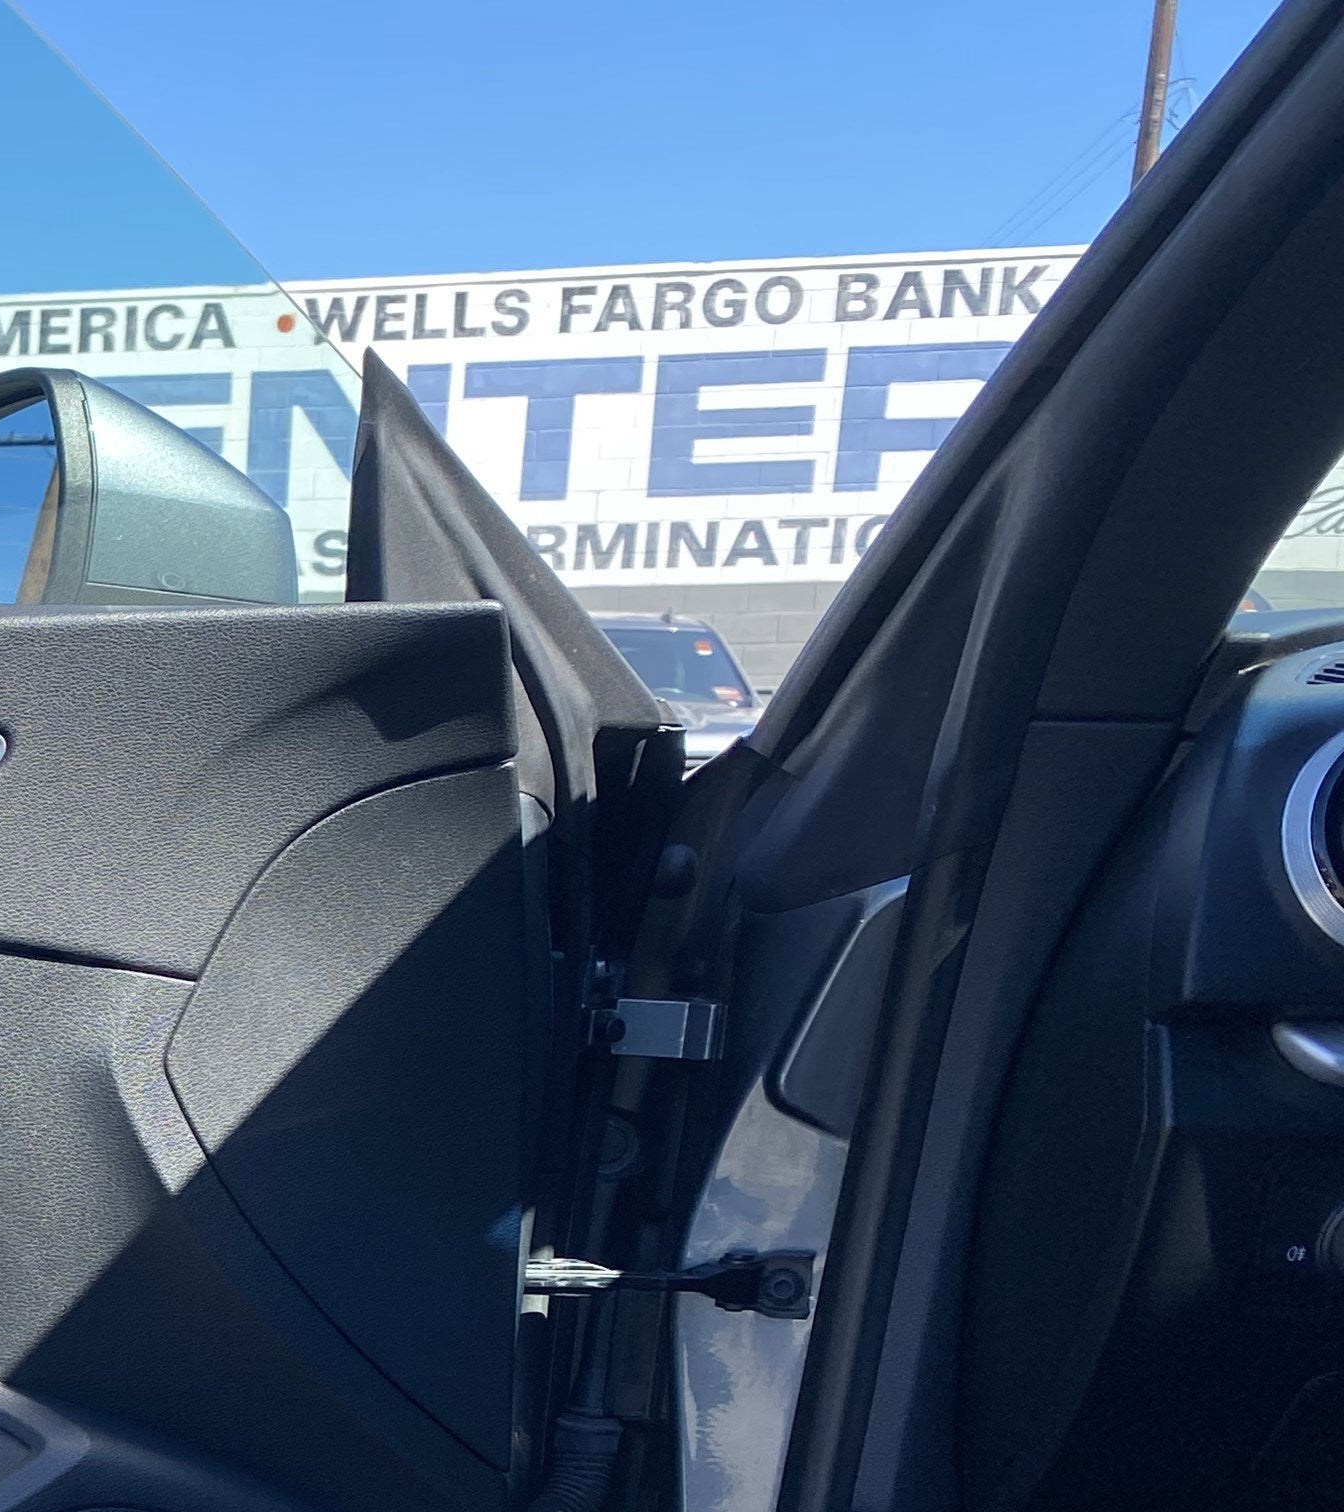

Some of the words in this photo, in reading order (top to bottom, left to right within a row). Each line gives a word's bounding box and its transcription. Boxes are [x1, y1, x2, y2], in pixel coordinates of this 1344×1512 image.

[304, 285, 530, 344] WELLS
[558, 274, 804, 335] FARGO
[834, 263, 1050, 322] BANK
